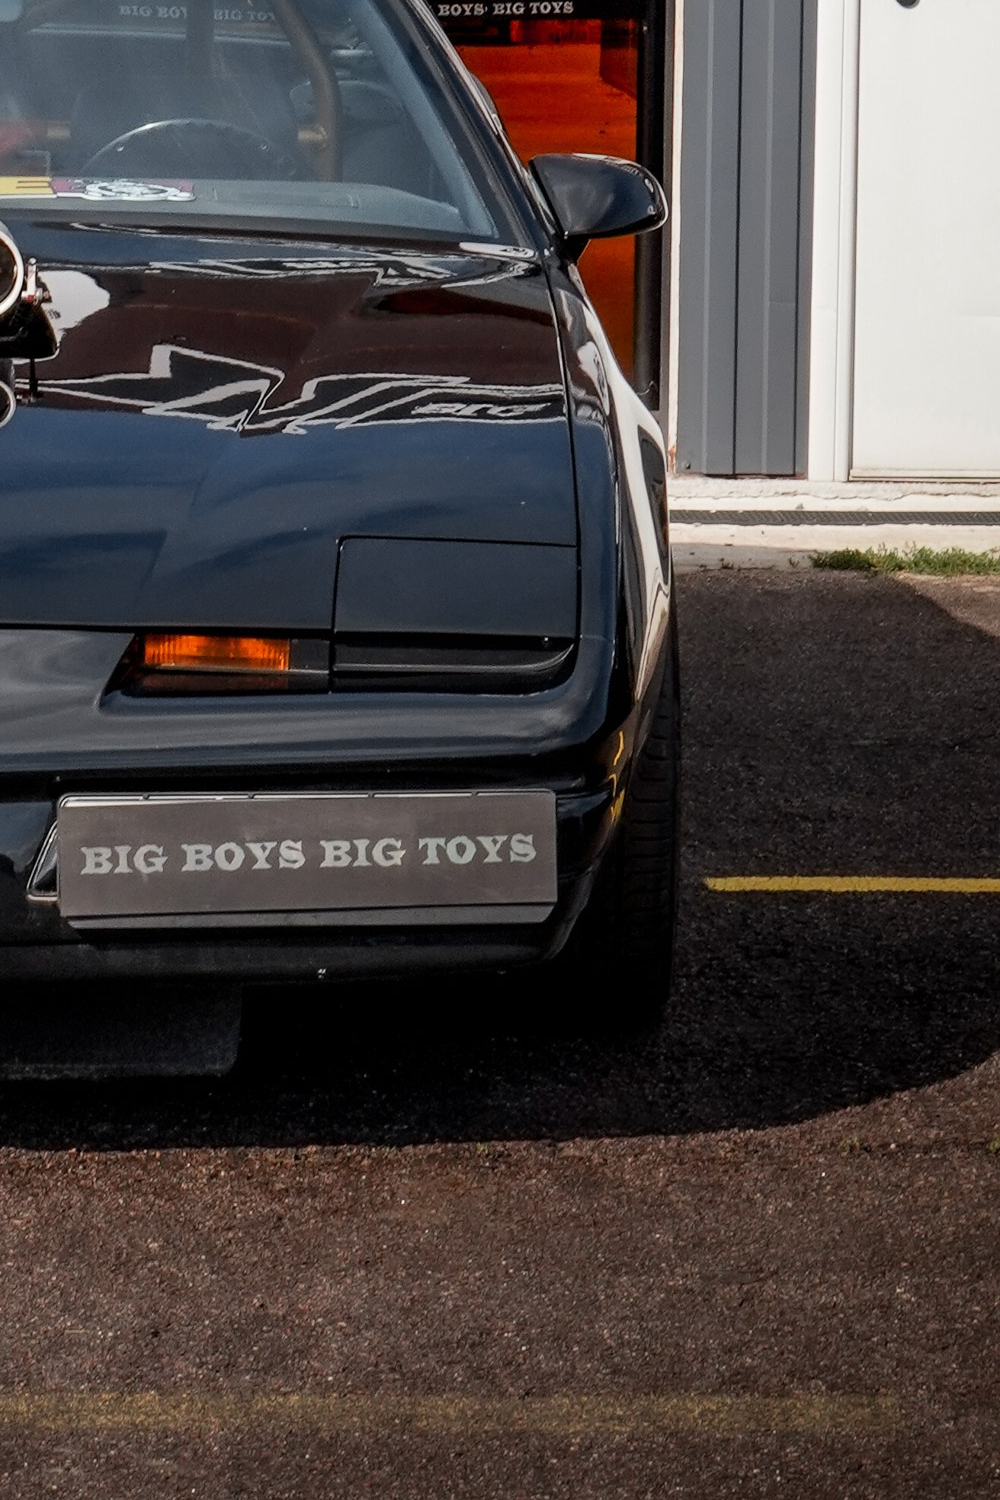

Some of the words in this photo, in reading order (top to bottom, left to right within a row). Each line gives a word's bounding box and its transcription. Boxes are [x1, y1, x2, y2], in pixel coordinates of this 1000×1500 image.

[492, 2, 526, 16] BIG
[529, 1, 575, 15] TOYS
[79, 843, 169, 877] BIG
[180, 838, 306, 874] BOYS
[319, 836, 407, 870] BIG
[418, 832, 538, 866] TOYS
